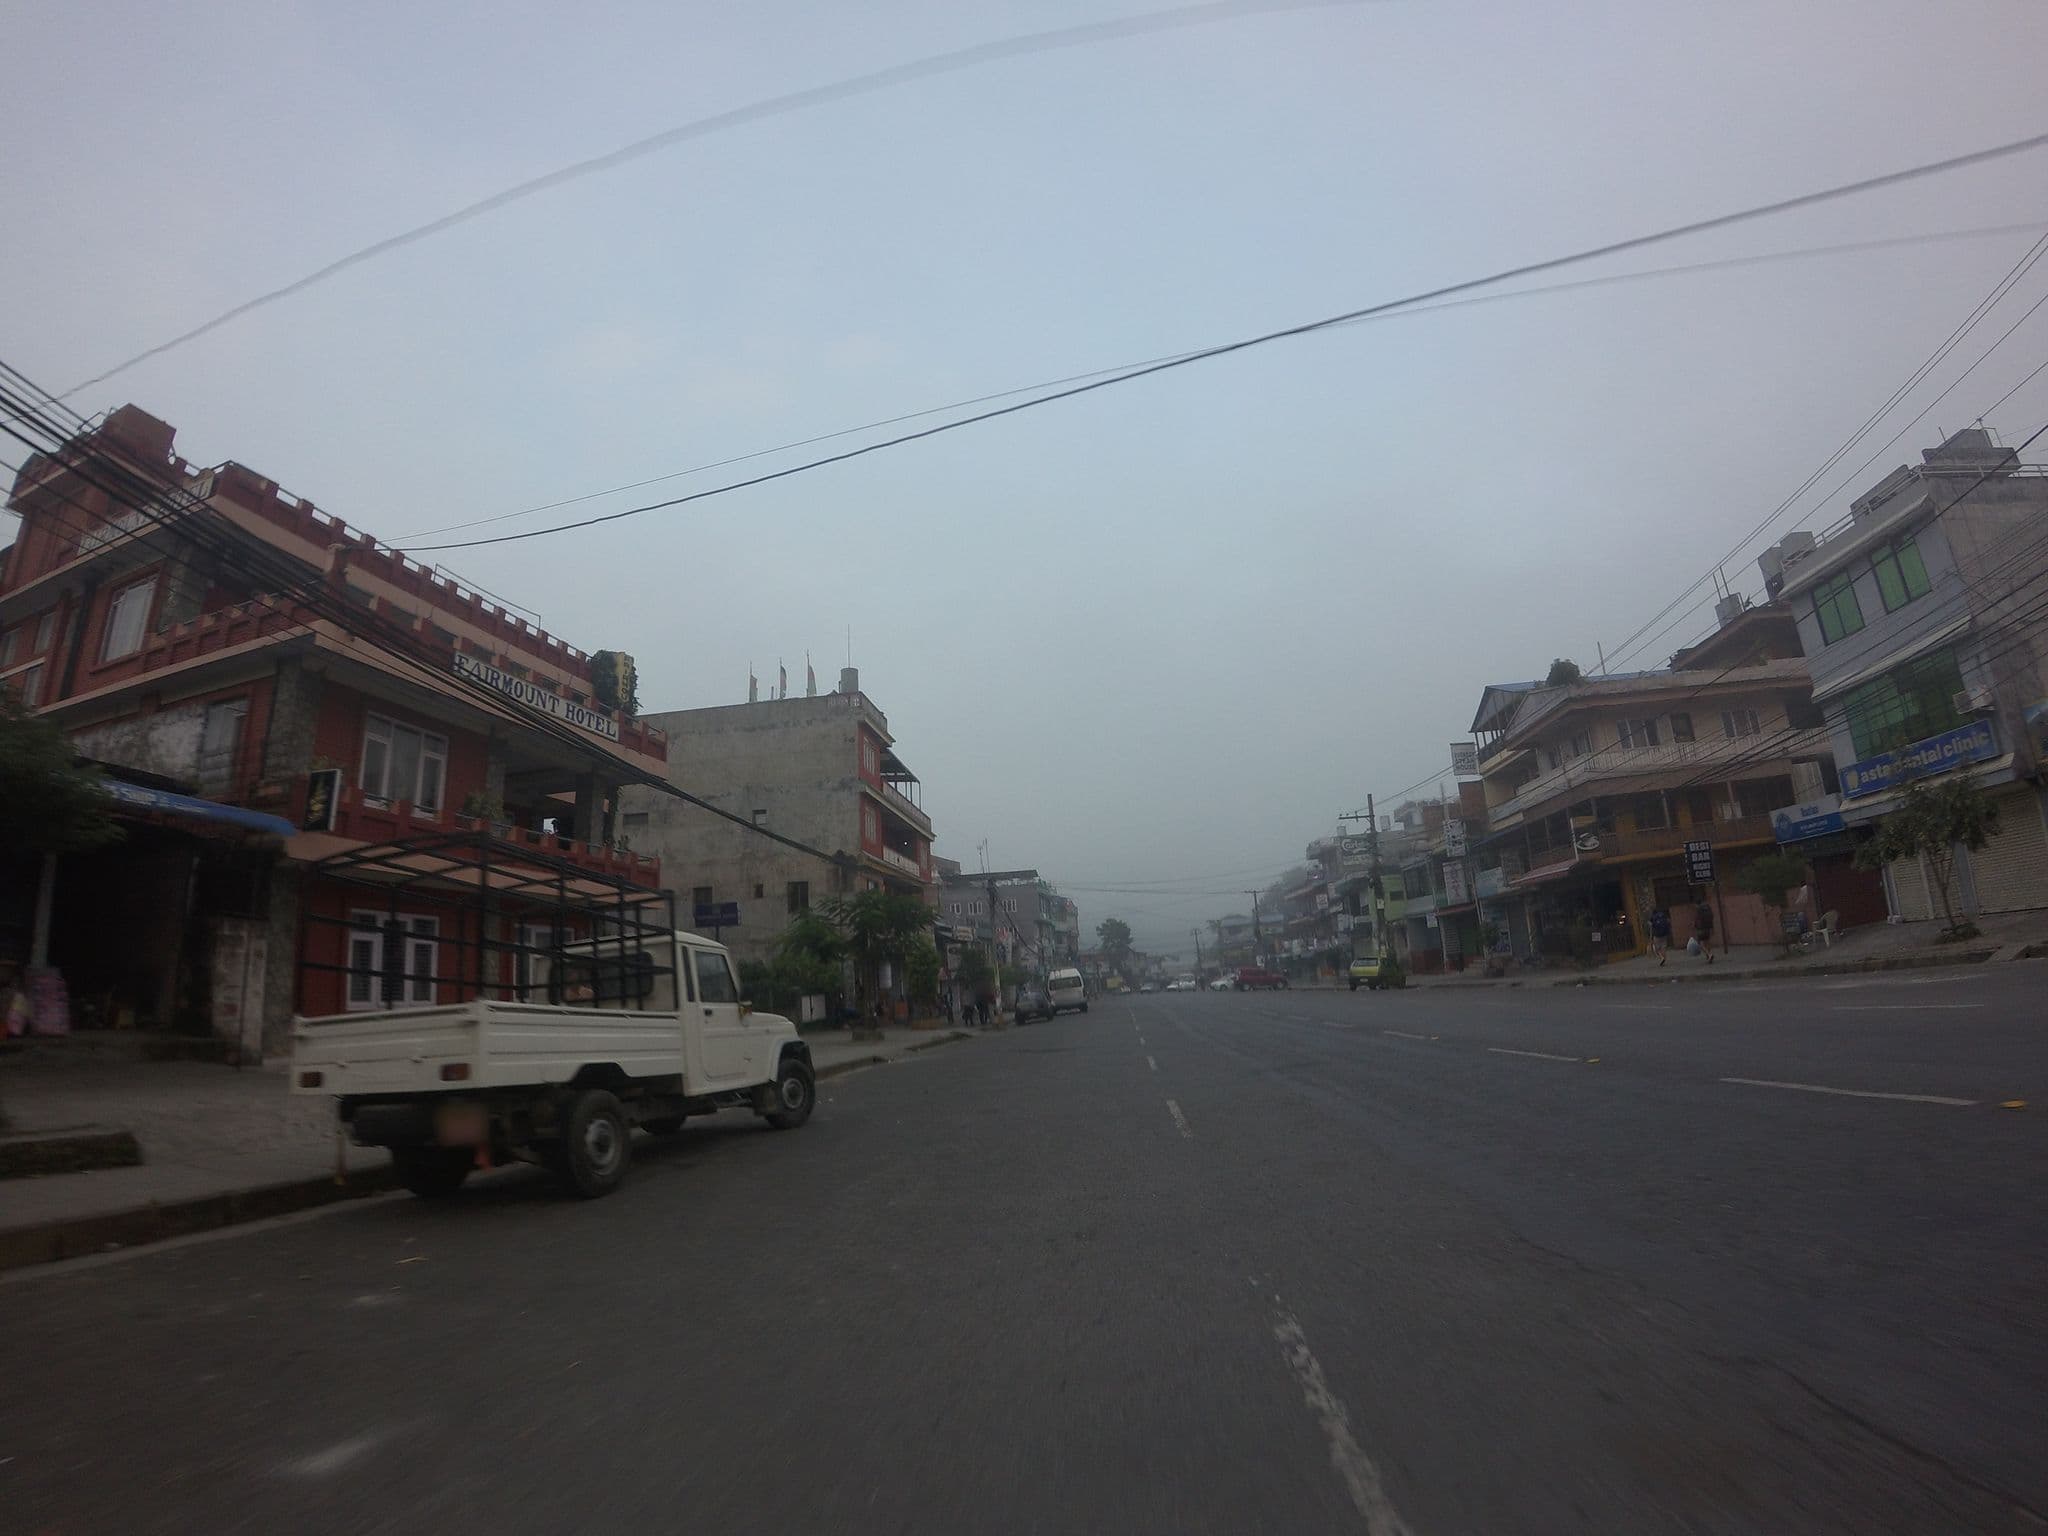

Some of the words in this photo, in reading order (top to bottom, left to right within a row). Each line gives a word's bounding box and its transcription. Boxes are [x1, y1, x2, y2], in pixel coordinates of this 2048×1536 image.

[454, 654, 560, 715] FAIRMOUNT
[565, 702, 617, 738] HOTEL
[1943, 730, 1990, 758] clinic
[1689, 841, 1709, 851] DESI
[1691, 851, 1710, 862] BAR
